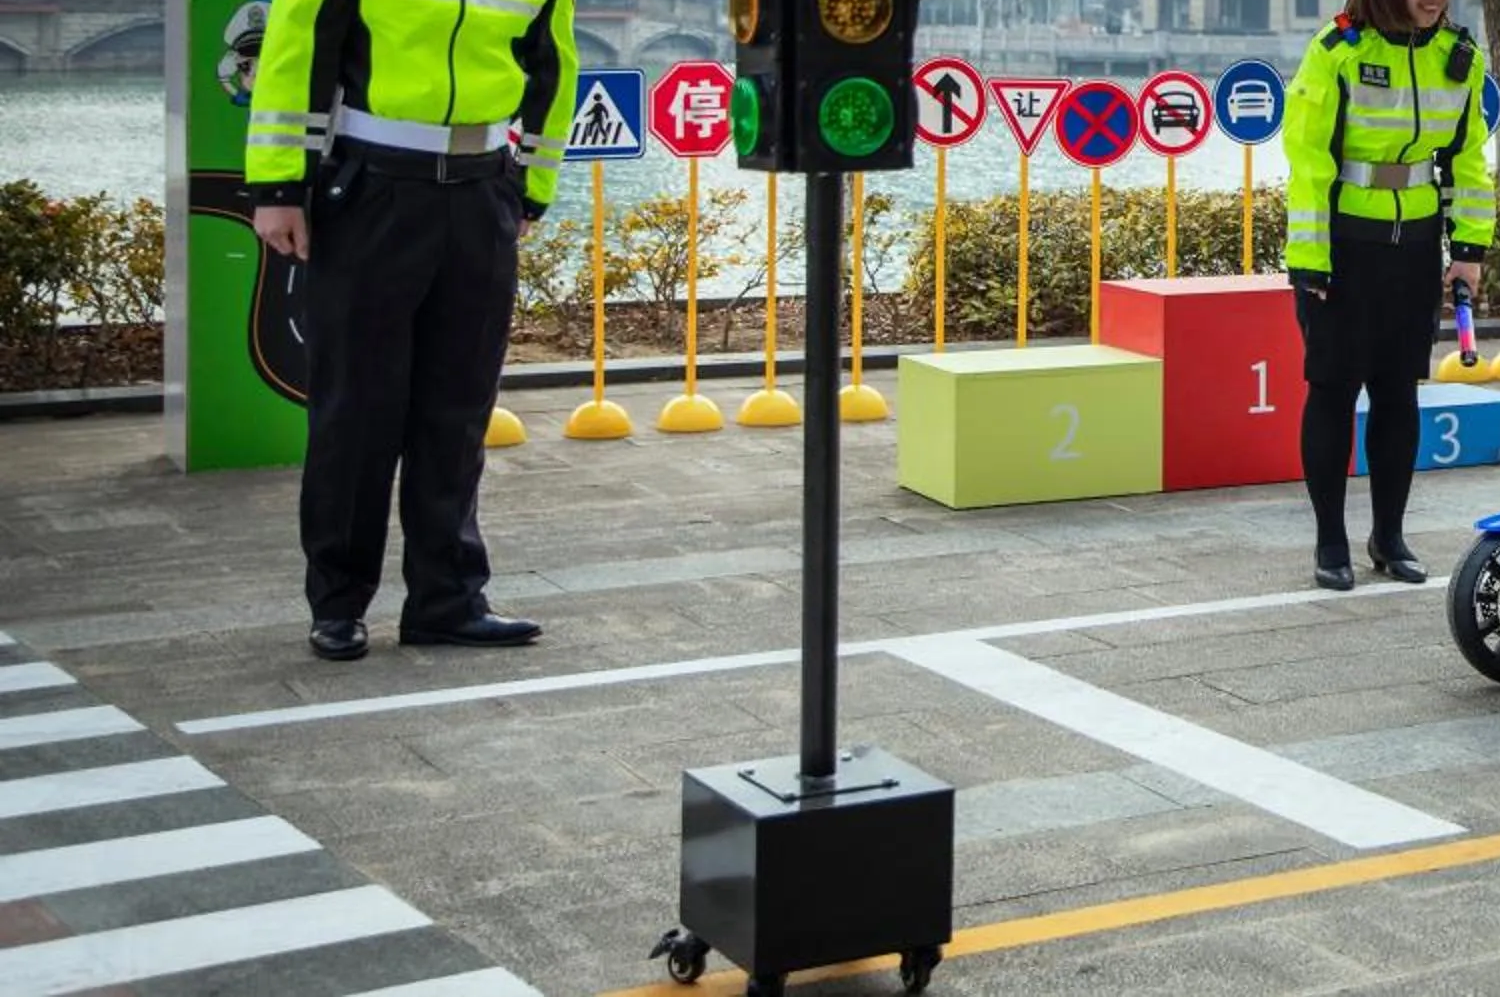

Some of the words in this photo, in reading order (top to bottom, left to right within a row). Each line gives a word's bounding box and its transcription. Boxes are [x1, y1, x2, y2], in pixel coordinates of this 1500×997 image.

[668, 79, 728, 140] 停
[1012, 90, 1041, 117] 让
[1247, 360, 1276, 414] 1
[1047, 403, 1083, 461] 2
[1432, 412, 1461, 464] 3
